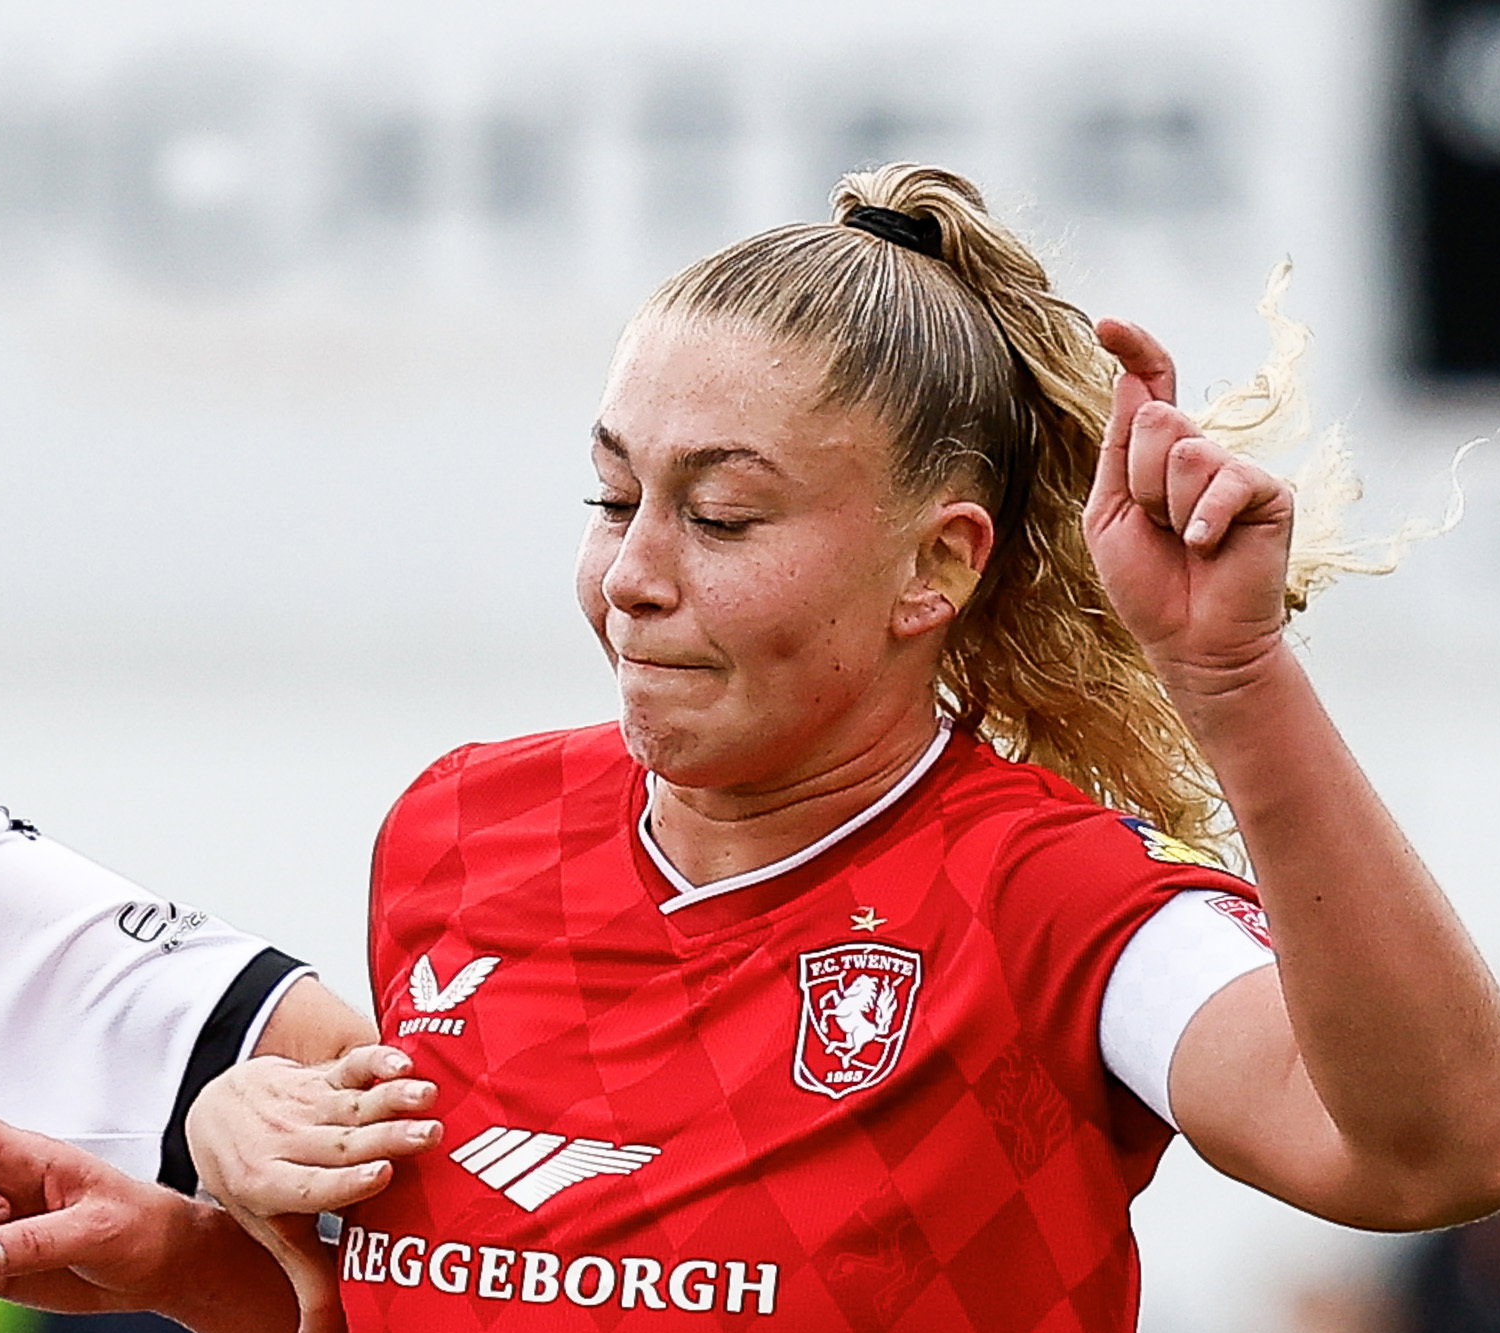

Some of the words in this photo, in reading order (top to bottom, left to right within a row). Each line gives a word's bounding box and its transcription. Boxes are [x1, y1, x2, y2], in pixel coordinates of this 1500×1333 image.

[810, 957, 840, 977] F.C.
[840, 953, 914, 977] TWENTE
[825, 1070, 864, 1083] 1965
[342, 1225, 779, 1315] REGGEBORGH
